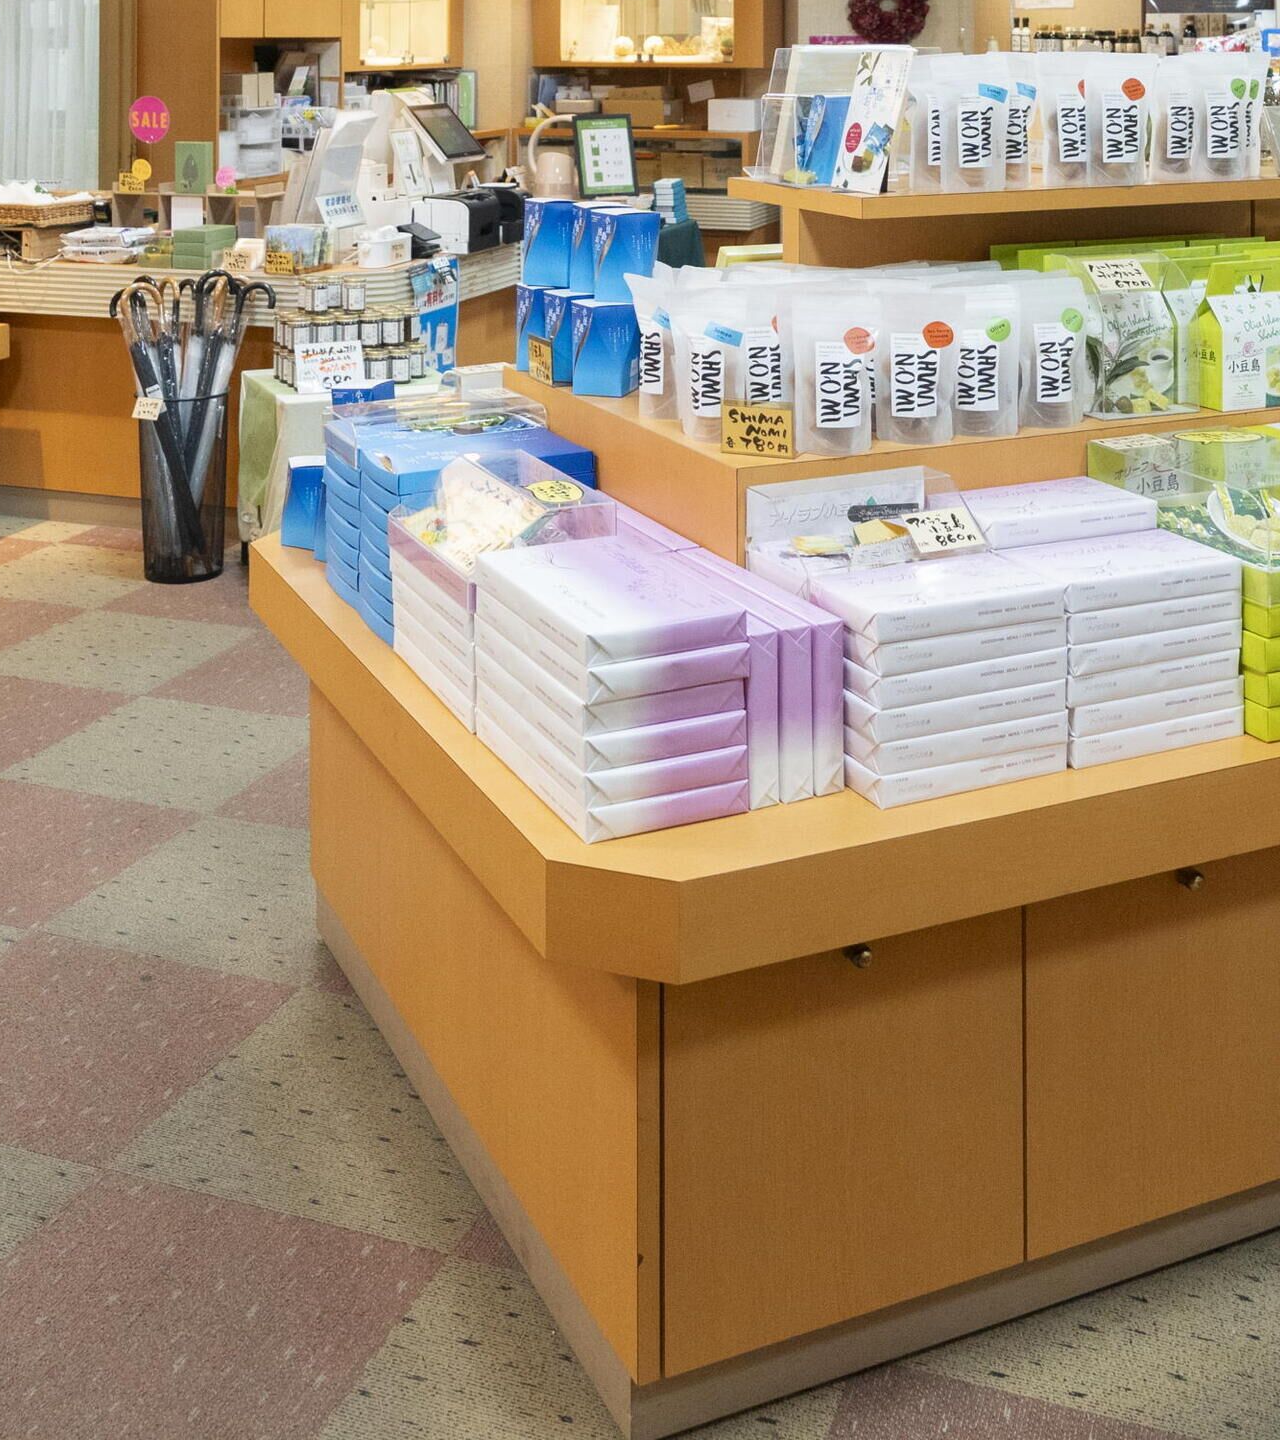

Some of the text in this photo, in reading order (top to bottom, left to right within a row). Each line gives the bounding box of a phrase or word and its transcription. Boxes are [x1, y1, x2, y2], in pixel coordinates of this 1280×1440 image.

[132, 112, 167, 128] SALE
[1192, 349, 1216, 362] 小豆島
[1228, 358, 1261, 373] 小豆島
[728, 409, 785, 425] SHIMA
[745, 424, 788, 439] NOMI
[1136, 473, 1179, 494] 小豆島
[935, 534, 977, 548] 860円
